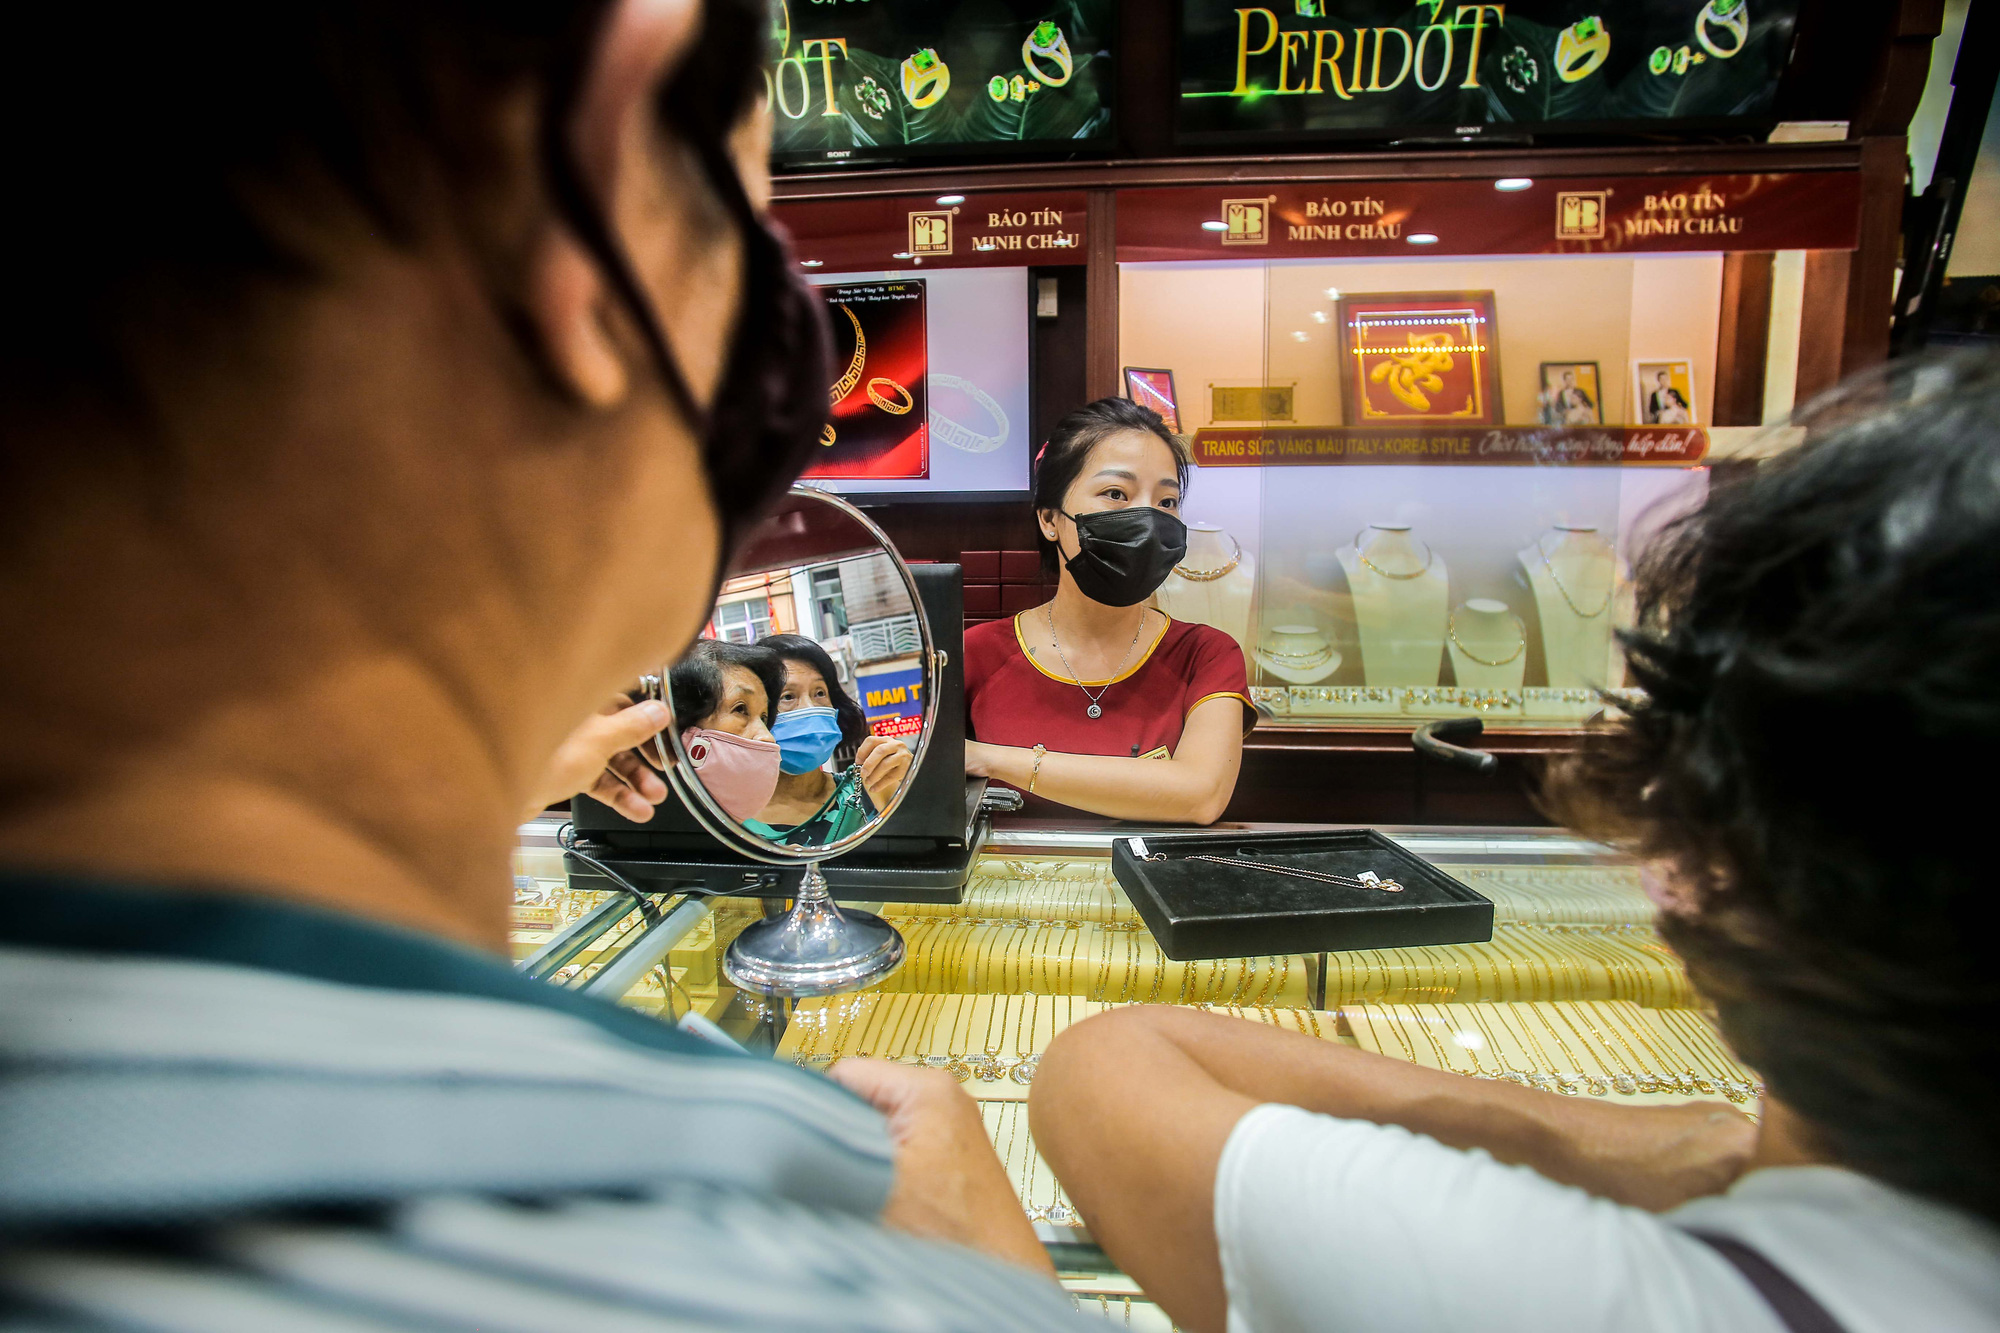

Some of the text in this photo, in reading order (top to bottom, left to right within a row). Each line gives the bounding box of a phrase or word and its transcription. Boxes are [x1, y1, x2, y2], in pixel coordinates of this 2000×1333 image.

[1230, 4, 1504, 101] PERIDOT
[1306, 196, 1385, 217] BẢO TÍN
[1644, 188, 1726, 211] BẢO TÍN
[988, 207, 1062, 227] BẢO TÍN
[1625, 214, 1743, 235] MINH CHÂU
[972, 230, 1079, 250] MINH CHÂU
[1288, 220, 1401, 241] MINH CHÂU
[1202, 440, 1244, 456] TRANG
[1248, 436, 1275, 455] SỨC
[1278, 436, 1312, 455] VÀNG
[1431, 437, 1471, 454] STYLE
